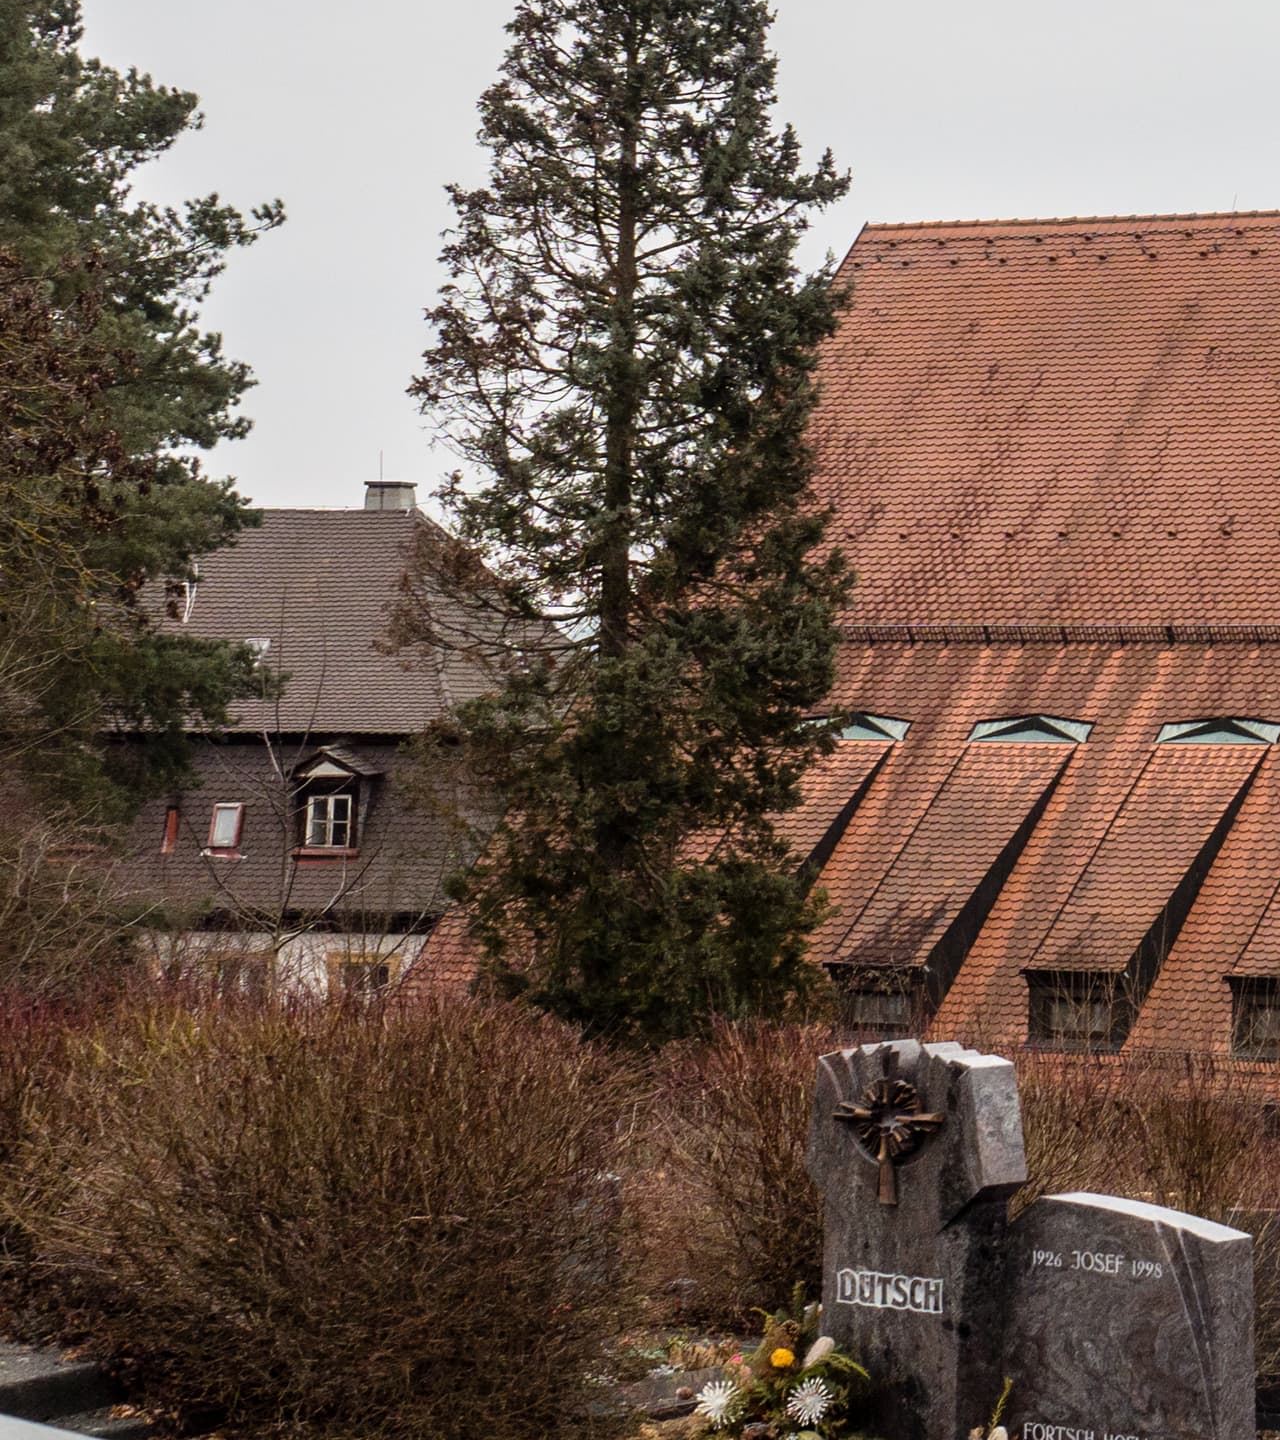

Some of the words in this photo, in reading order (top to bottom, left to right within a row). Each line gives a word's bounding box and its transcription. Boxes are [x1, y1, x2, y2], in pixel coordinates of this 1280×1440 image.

[1032, 1249, 1062, 1268] 1926
[1071, 1250, 1124, 1274] JOSEF
[1131, 1259, 1163, 1279] 1998
